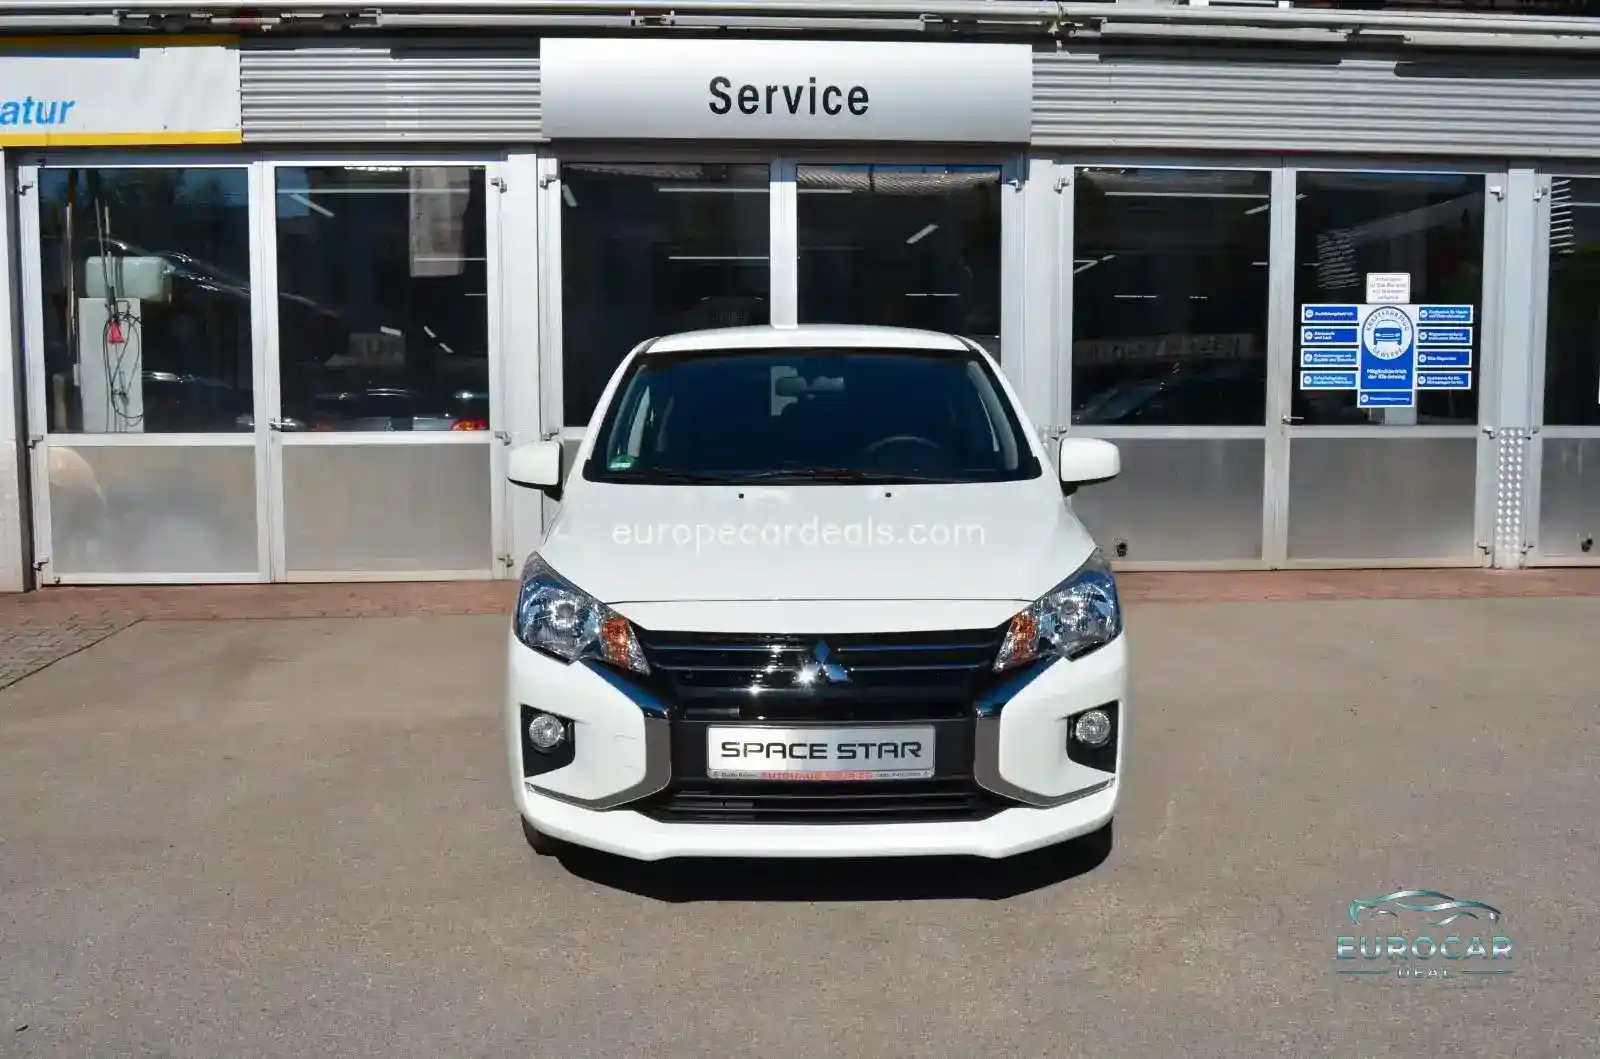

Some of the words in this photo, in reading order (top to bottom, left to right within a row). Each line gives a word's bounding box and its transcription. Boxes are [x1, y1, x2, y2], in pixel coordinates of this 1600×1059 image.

[708, 75, 870, 116] Service
[0, 96, 76, 126] atur
[721, 741, 828, 760] SPACE
[837, 741, 922, 760] STAR
